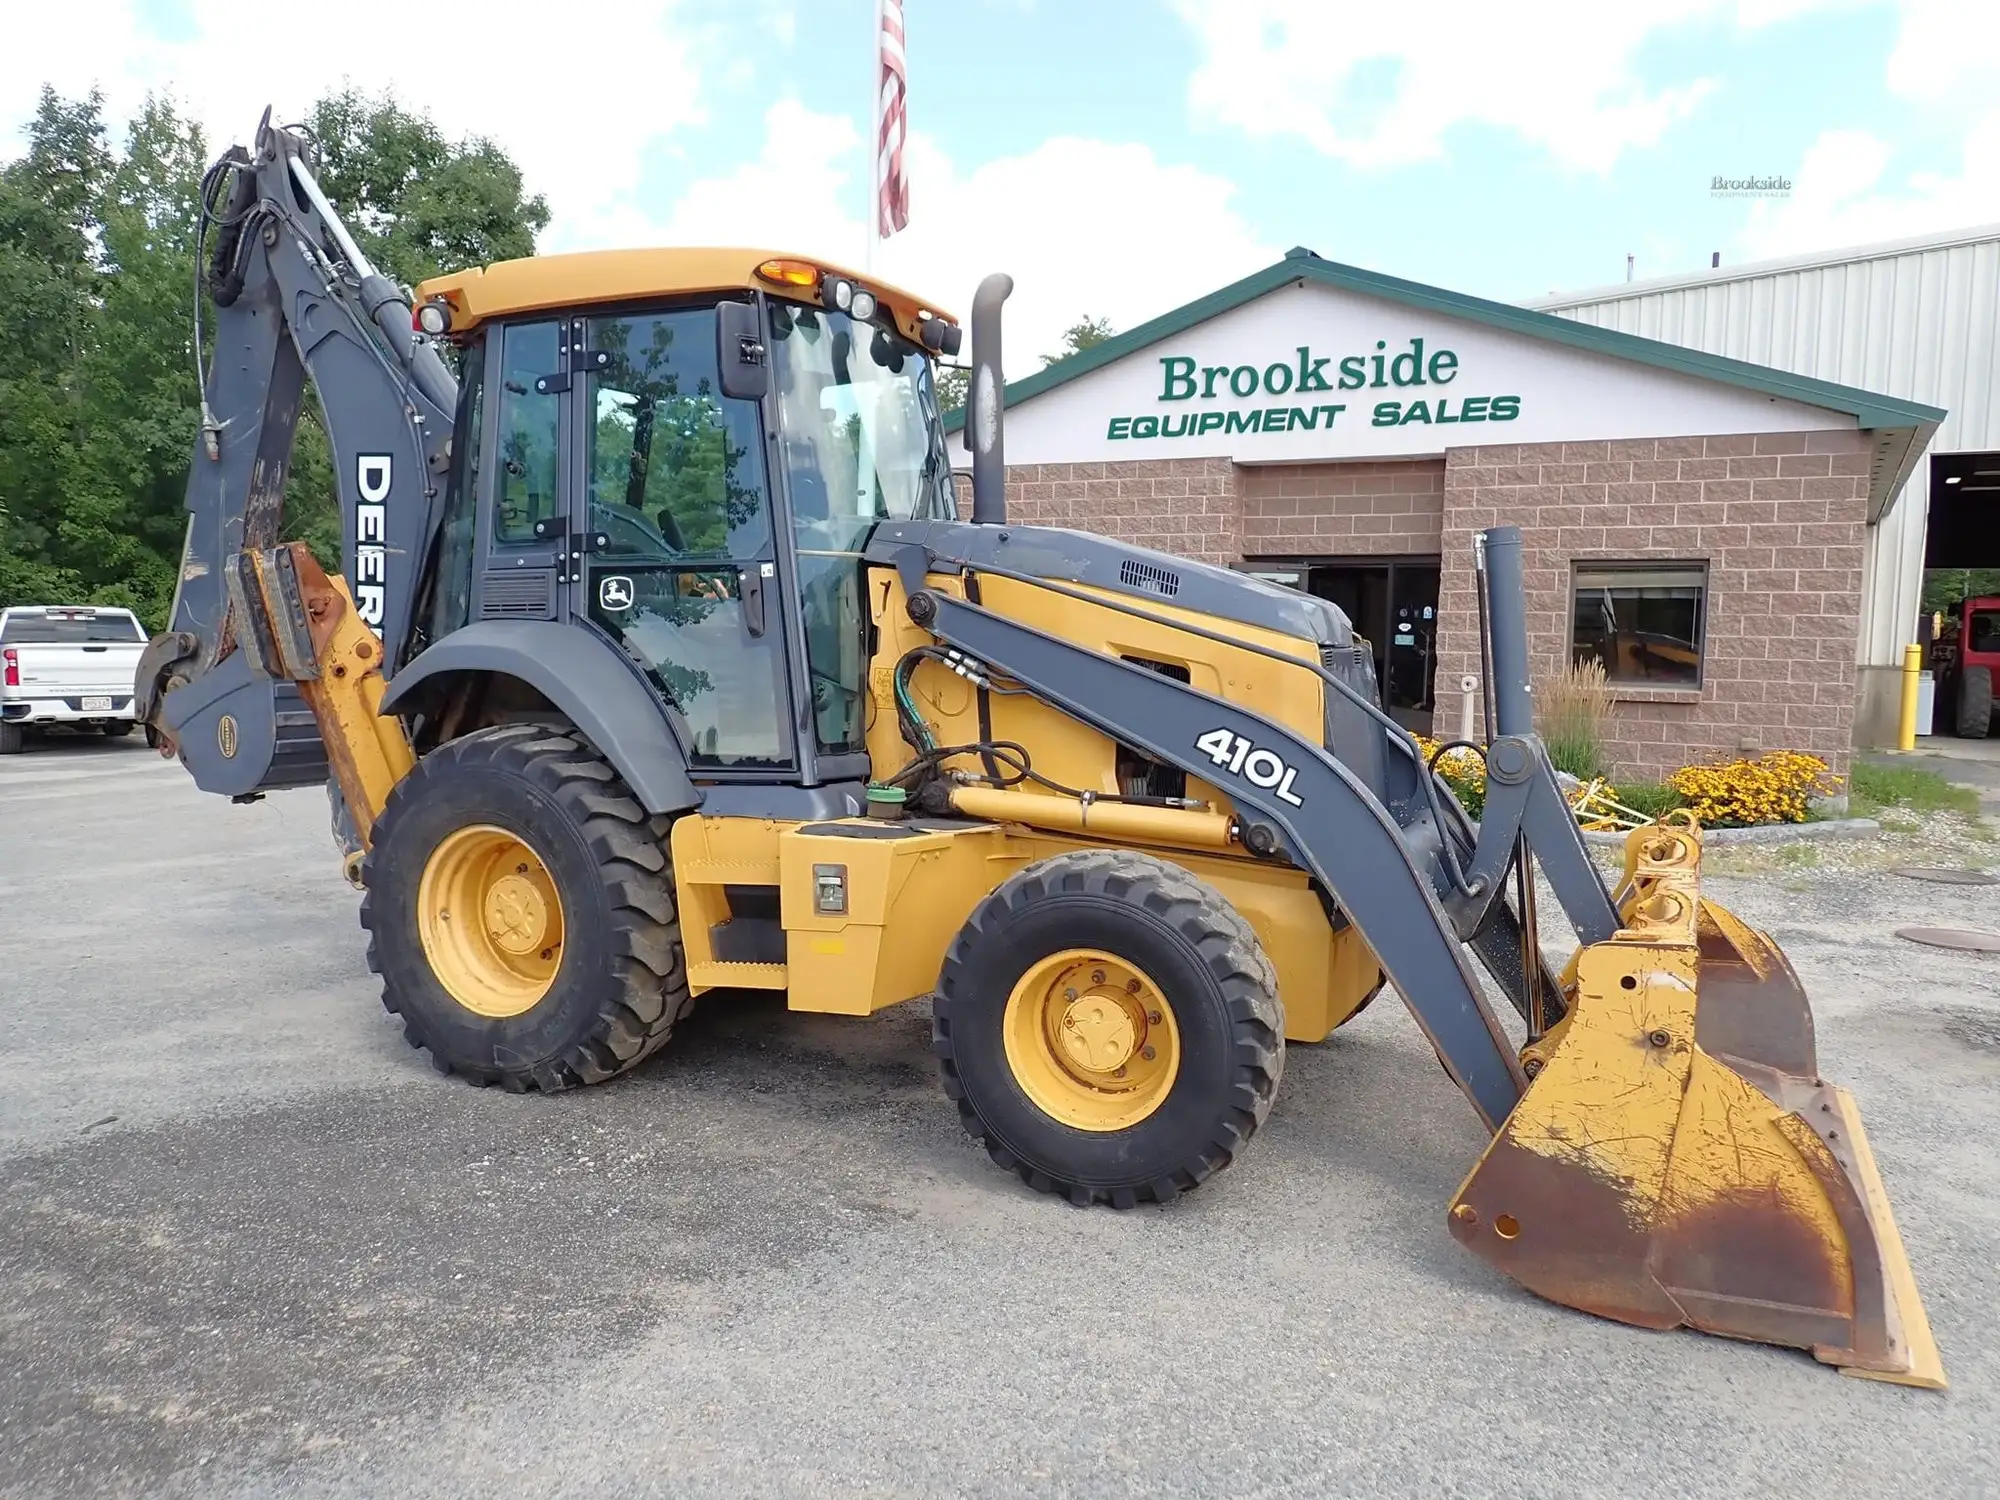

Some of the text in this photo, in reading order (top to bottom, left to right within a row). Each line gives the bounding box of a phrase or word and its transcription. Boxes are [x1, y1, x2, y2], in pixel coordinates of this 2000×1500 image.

[1157, 337, 1459, 402] Brookside
[1107, 395, 1521, 440] EQUIPMENT SALES
[1195, 728, 1304, 808] 410L
